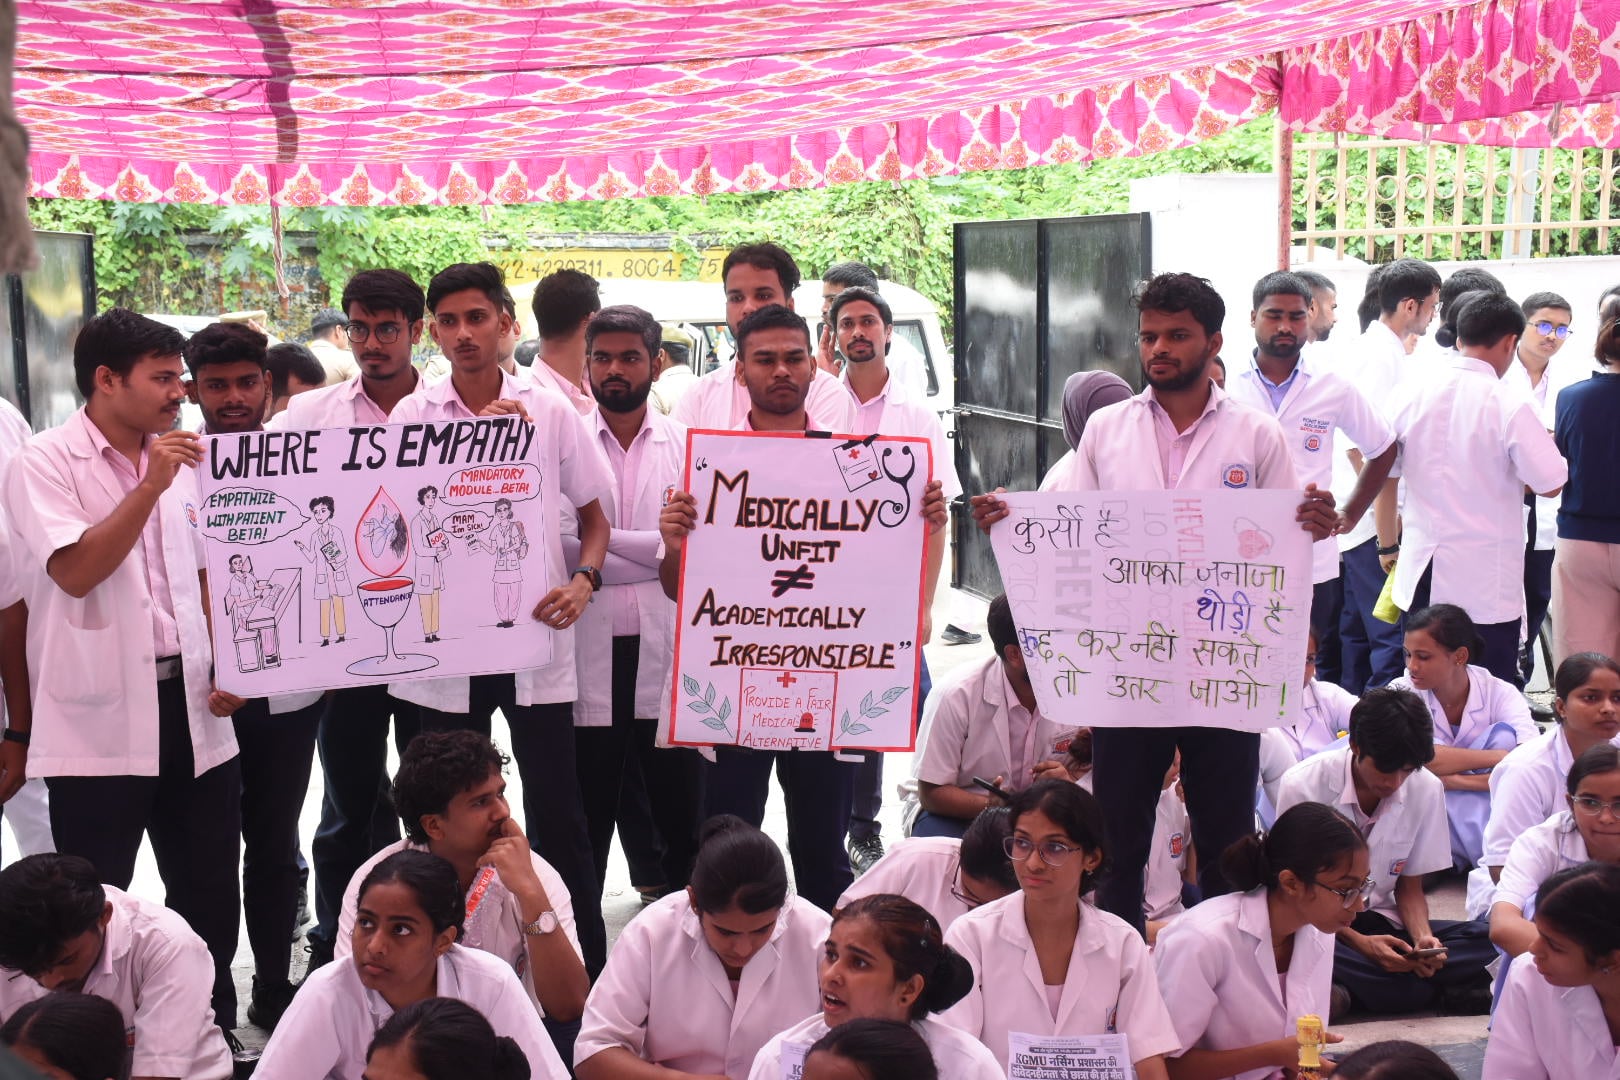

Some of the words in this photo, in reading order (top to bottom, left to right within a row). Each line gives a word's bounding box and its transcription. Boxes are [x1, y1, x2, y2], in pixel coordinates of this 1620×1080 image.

[210, 430, 321, 480] WHERE
[342, 427, 387, 471] IS
[396, 418, 537, 467] EMPATHY
[461, 468, 524, 483] MANDATORY
[210, 491, 276, 508] EMPATHIZE
[500, 483, 530, 495] BETA!
[207, 513, 235, 528] WITH
[235, 510, 287, 526] PATIENT
[452, 514, 475, 525] MAM
[1012, 504, 1085, 554] कुर्सी
[1094, 509, 1121, 548] है
[228, 528, 268, 541] BETA!
[761, 533, 841, 564] UNFIT
[1103, 557, 1186, 586] आपका
[691, 588, 866, 630] ACADEMICALLY
[1197, 588, 1256, 634] थोड़ी
[1264, 598, 1294, 635] है
[1077, 628, 1127, 662] कर
[1130, 621, 1180, 663] नहीं
[1193, 632, 1267, 668] सकते
[1054, 656, 1091, 698] तो
[1107, 674, 1175, 704] उतर
[744, 685, 790, 708] PROVIDE
[796, 698, 802, 708] A
[806, 687, 832, 711] FAIR
[752, 712, 800, 728] MEDICAL
[742, 732, 822, 748] ALTERNATIVE
[1015, 1053, 1046, 1066] KGMU
[1049, 1054, 1075, 1067] नर्सिंग
[1107, 1055, 1117, 1067] की
